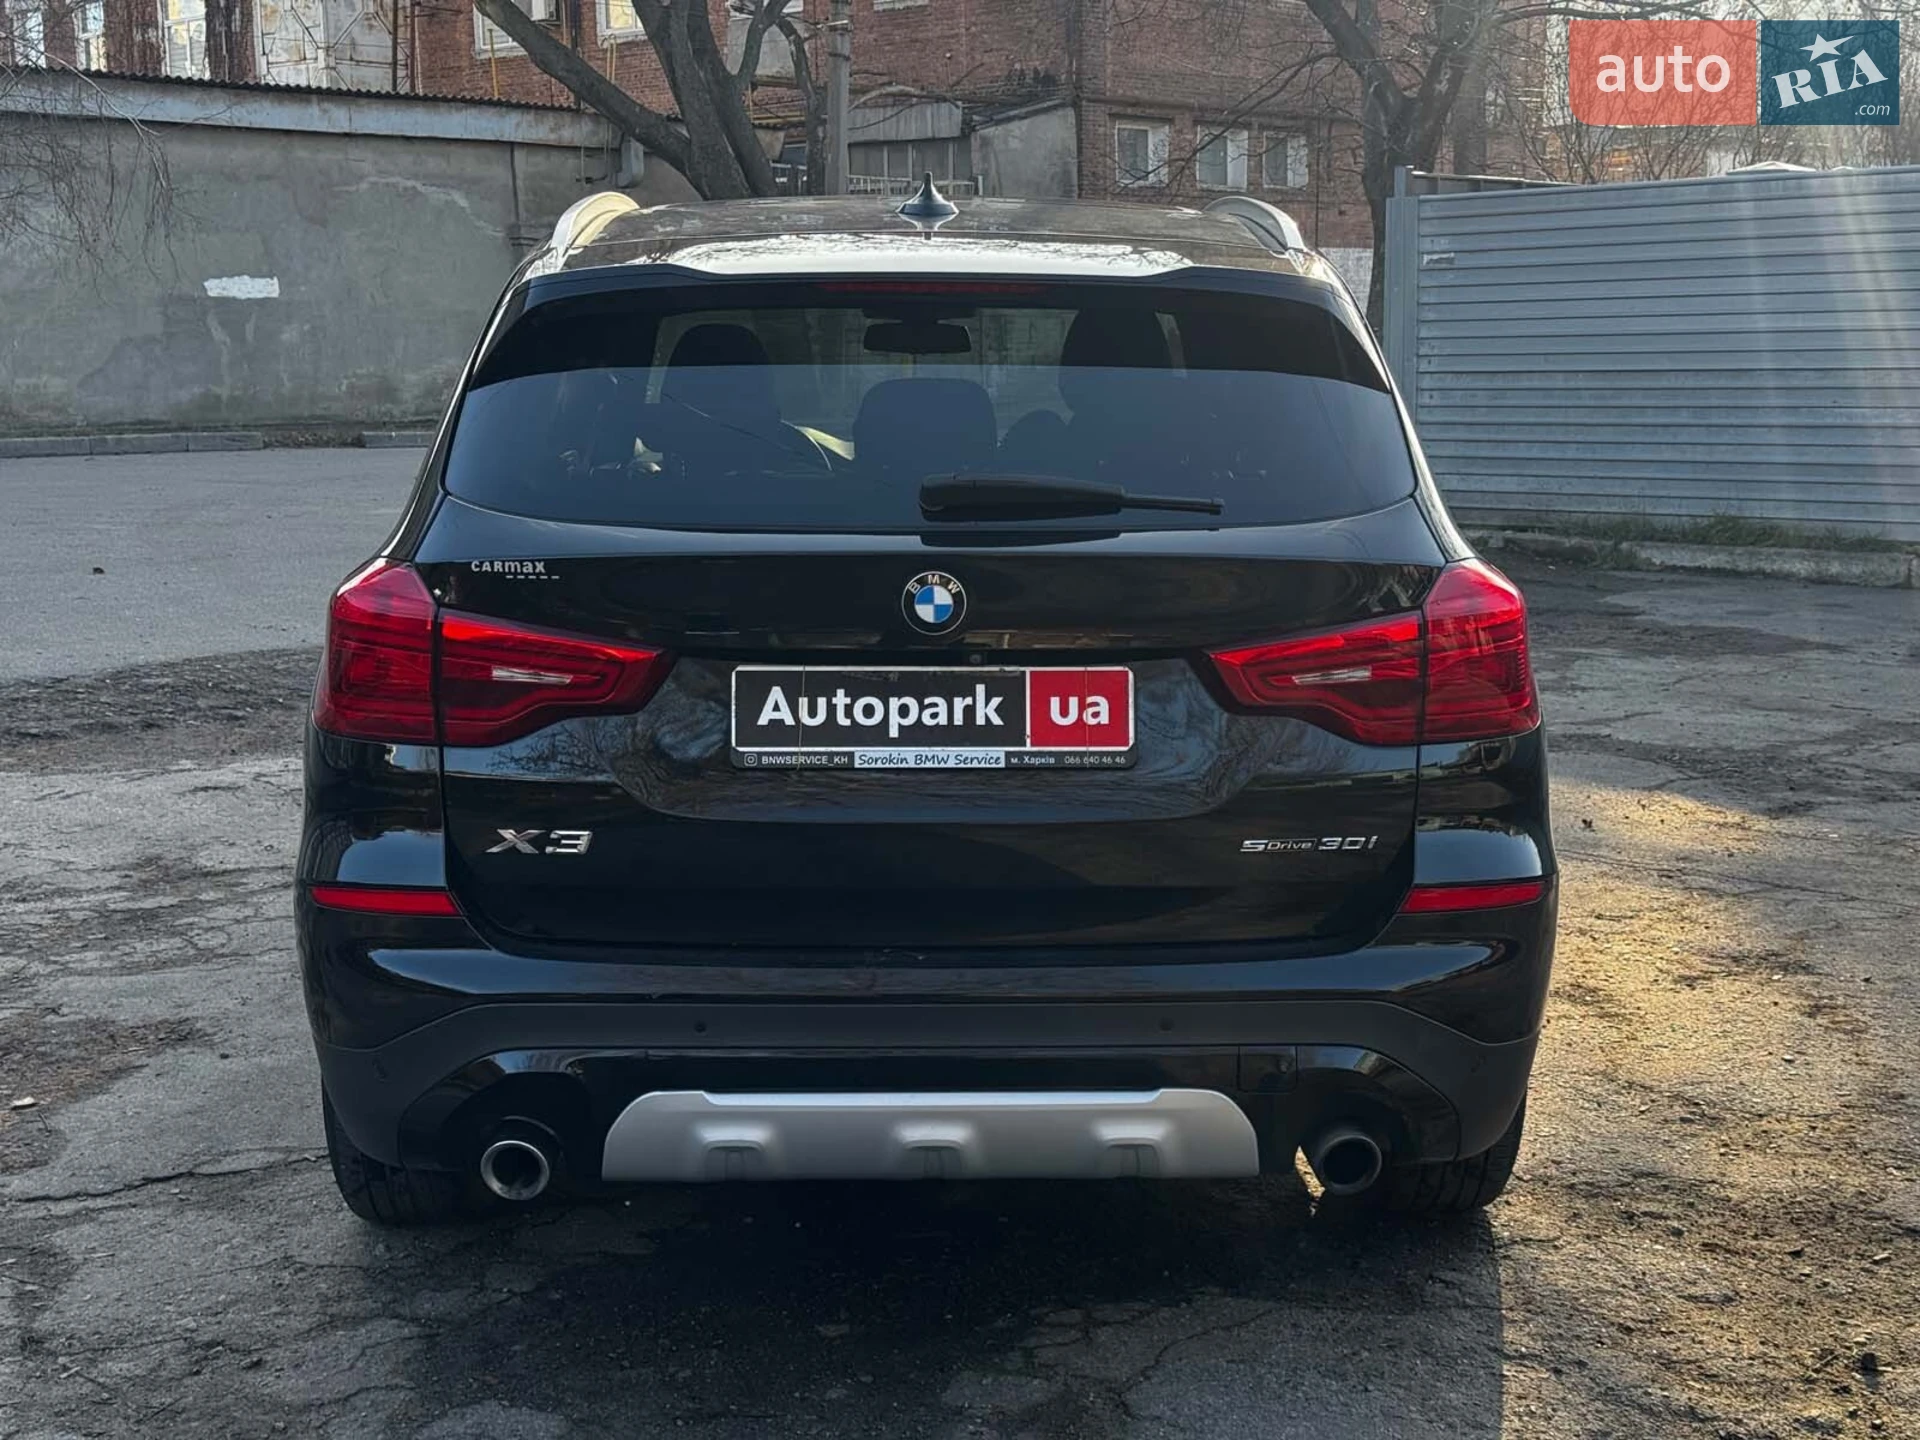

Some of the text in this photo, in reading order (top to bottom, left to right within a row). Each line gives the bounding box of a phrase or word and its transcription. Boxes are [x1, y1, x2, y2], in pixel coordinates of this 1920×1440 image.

[908, 574, 960, 595] BMW
[756, 683, 1110, 738] Autopark ua
[858, 753, 909, 766] Sorokin
[914, 754, 950, 766] BMW
[954, 753, 1001, 766] Service
[485, 828, 593, 855] X3
